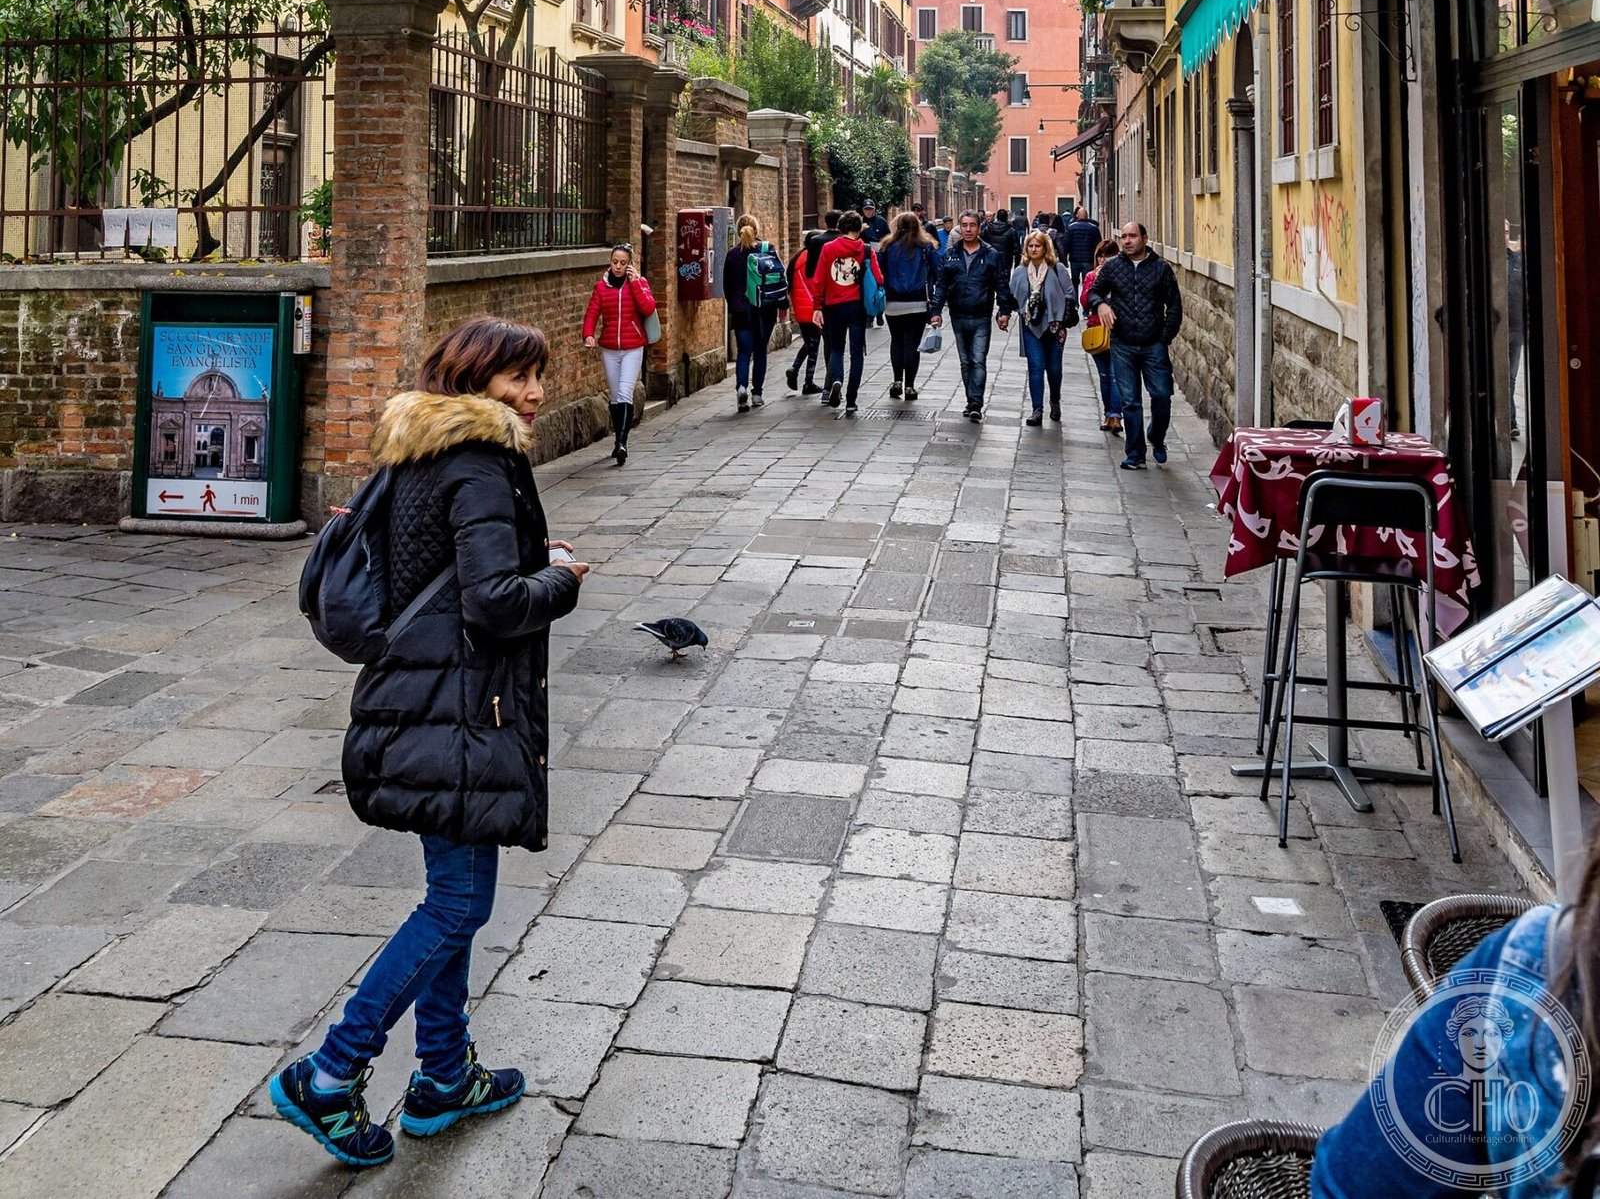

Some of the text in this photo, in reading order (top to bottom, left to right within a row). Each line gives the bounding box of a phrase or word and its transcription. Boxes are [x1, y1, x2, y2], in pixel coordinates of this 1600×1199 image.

[160, 331, 271, 344] SCUOLA GRANDE
[167, 344, 263, 356] SAN GIOVANNI
[172, 356, 257, 369] EVANGELISTA
[233, 493, 260, 505] 1 min
